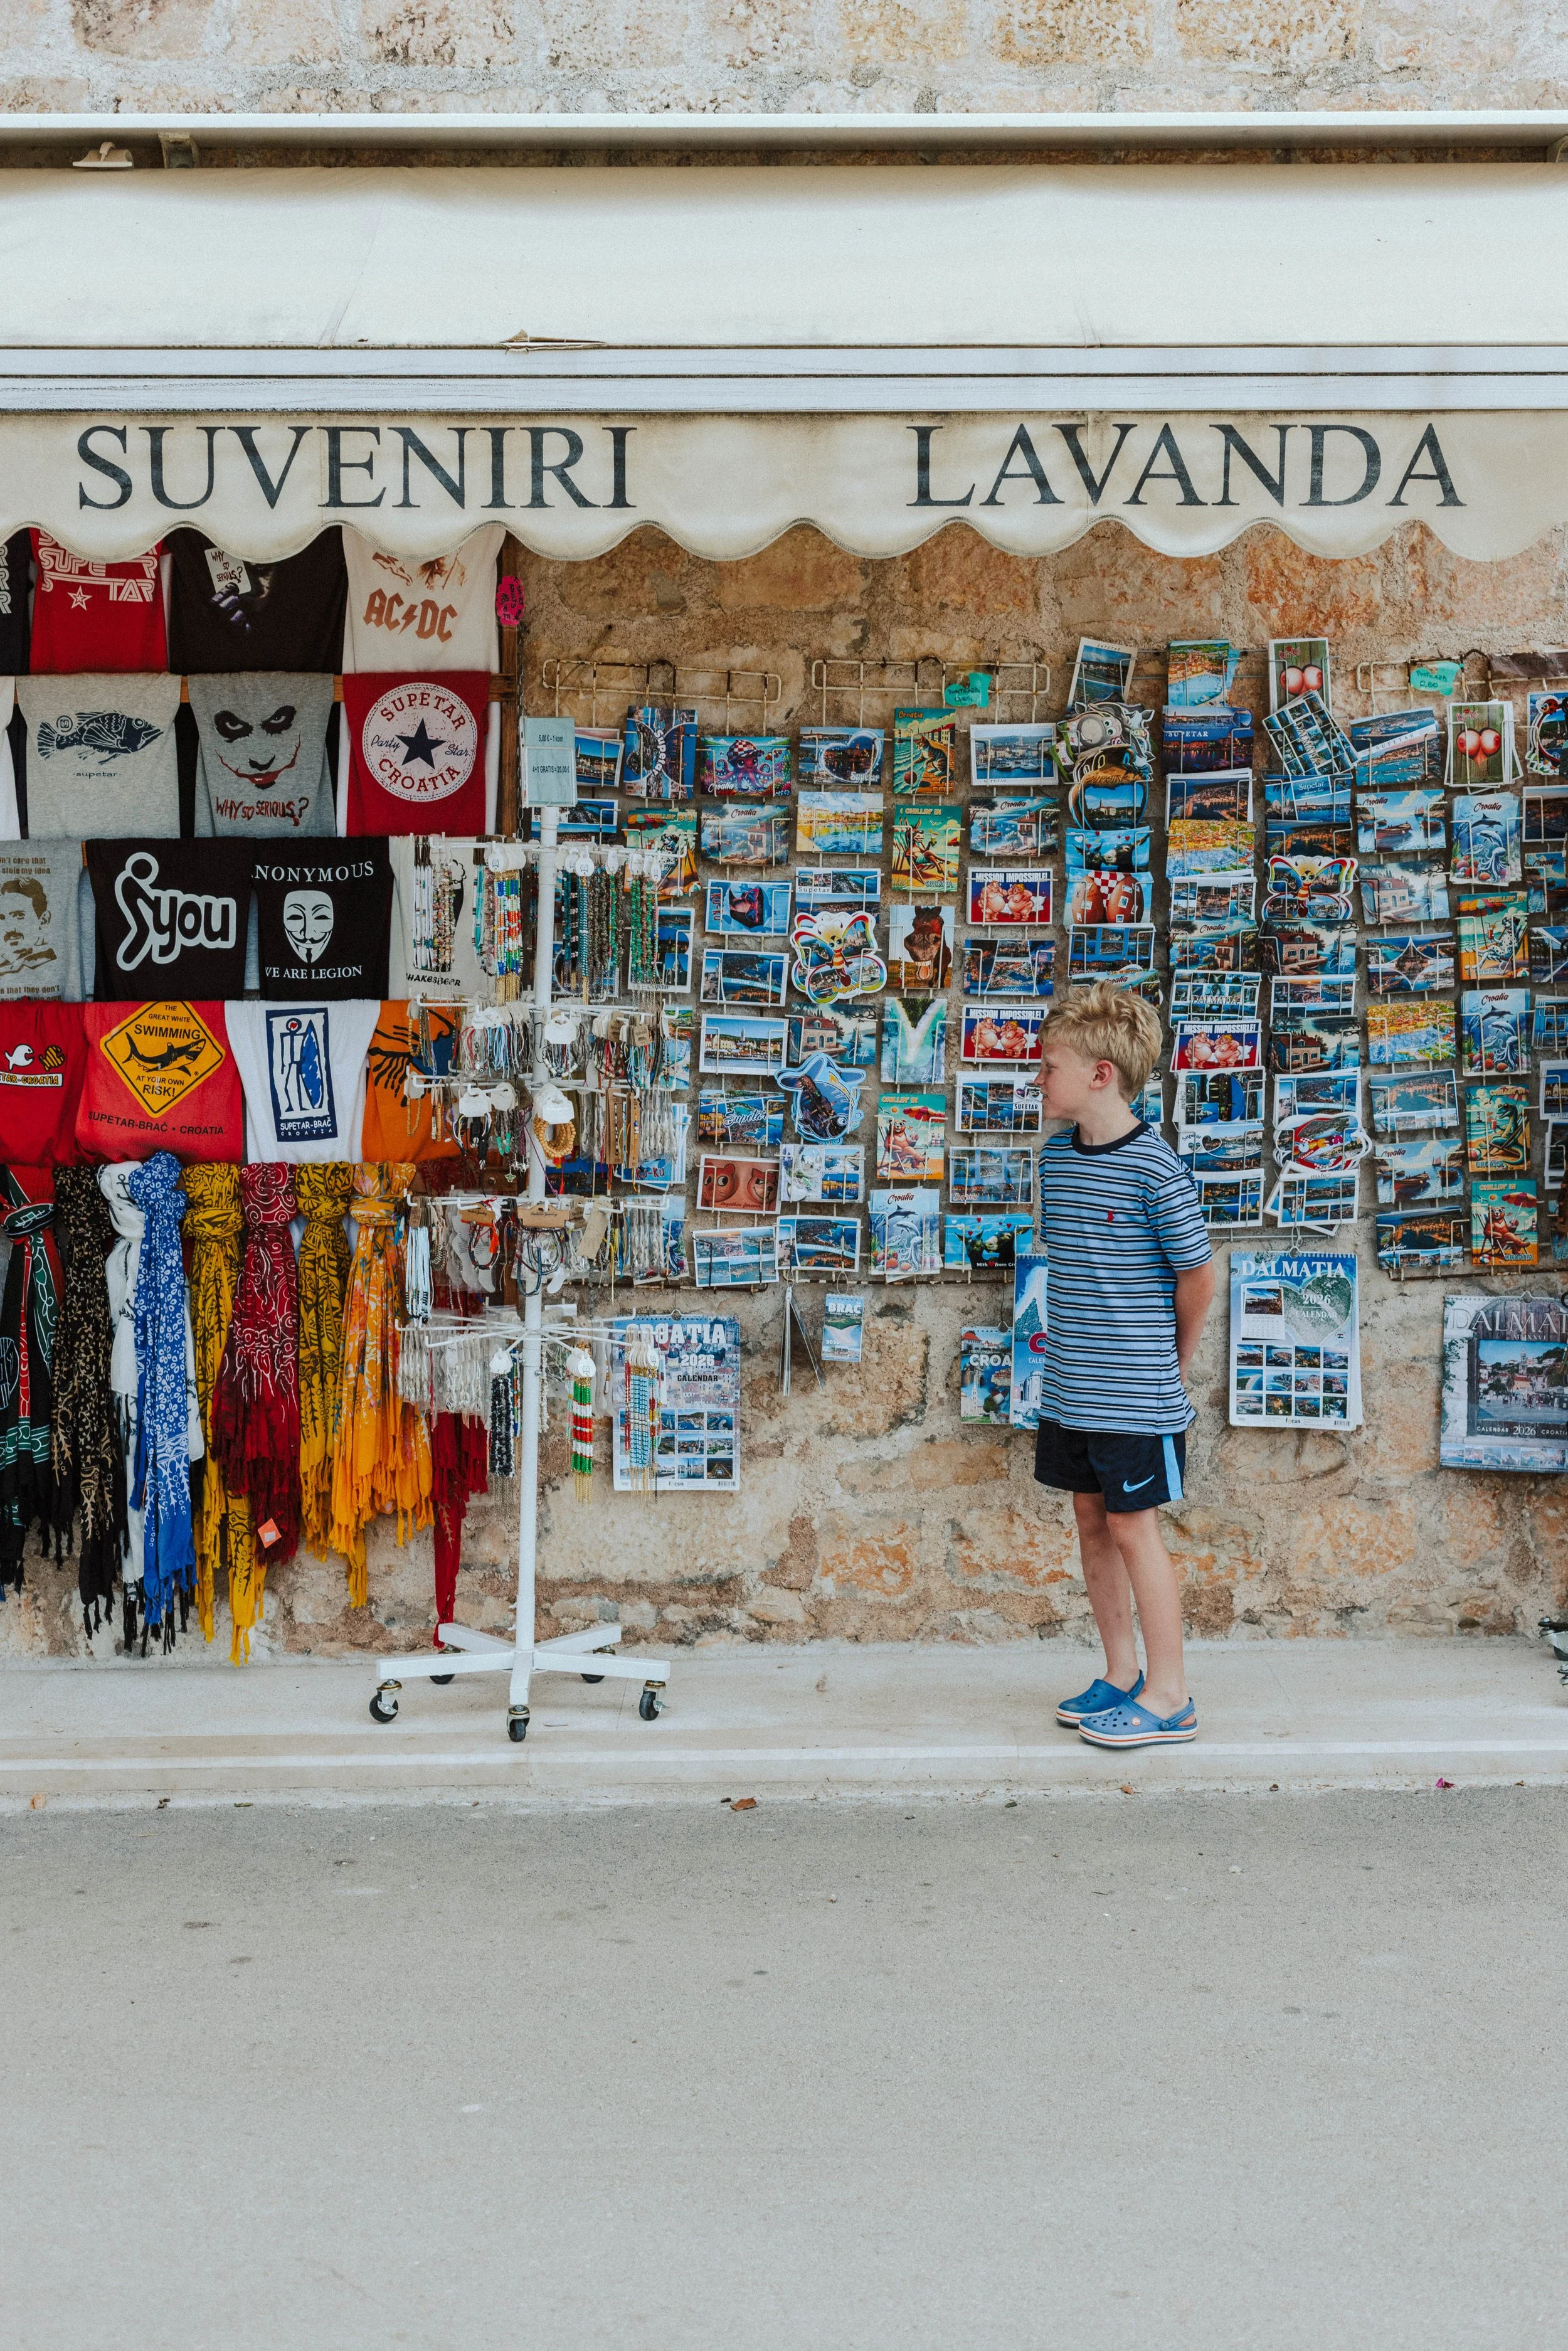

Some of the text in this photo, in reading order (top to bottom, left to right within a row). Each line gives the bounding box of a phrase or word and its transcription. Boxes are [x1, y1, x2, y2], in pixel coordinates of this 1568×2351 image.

[79, 425, 637, 509] SUVENIRI
[906, 422, 1468, 507] LAVANDA
[211, 551, 224, 562] WHY
[223, 562, 229, 570] SO
[380, 692, 466, 730] SUPETAR
[898, 710, 923, 719] Croatia
[371, 735, 469, 756] Party Star
[1376, 733, 1414, 750] SUPETAR
[652, 729, 667, 776] Supetar
[540, 765, 554, 773] GRATIS
[379, 758, 460, 792] CROATIA
[1298, 782, 1324, 790] Supetar
[216, 797, 243, 820] WHY
[241, 805, 255, 820] SO
[1000, 801, 1026, 810] Croatia
[1473, 802, 1502, 812] Croatia
[731, 809, 757, 818] Croatia
[252, 861, 374, 883] NONYMOUS
[976, 873, 1047, 882] MISSION IMPOSSIBLE!
[1200, 924, 1226, 932] Croatia
[283, 969, 307, 979] ARE
[311, 965, 362, 979] LEGION
[24, 985, 39, 994] they
[42, 984, 60, 993] don't
[1192, 995, 1239, 1004] DALMATIA
[1481, 993, 1509, 1005] Croatia
[171, 1014, 190, 1022] WHITE
[970, 1009, 1041, 1018] MISSION IMPOSSIBLE!
[134, 1024, 201, 1039] SWIMMING
[1184, 1024, 1255, 1032] MISSION IMPOSSIBLE!
[0, 1073, 59, 1085] TAR-CROATIA
[142, 1085, 176, 1097] RISK!
[724, 1108, 768, 1126] Supetar
[88, 1111, 224, 1135] SUPETAR-BRAČ CROATIA
[280, 1117, 331, 1130] SUPETAR-BRAČ
[637, 1168, 664, 1179] KU-KU
[887, 1194, 914, 1204] Croatia
[1241, 1260, 1345, 1278] DALMATIA
[1302, 1294, 1330, 1305] 2026
[828, 1302, 861, 1313] BRAČ
[681, 1354, 714, 1366] 2026
[970, 1354, 1012, 1366] CROA
[1513, 1426, 1535, 1435] 2026
